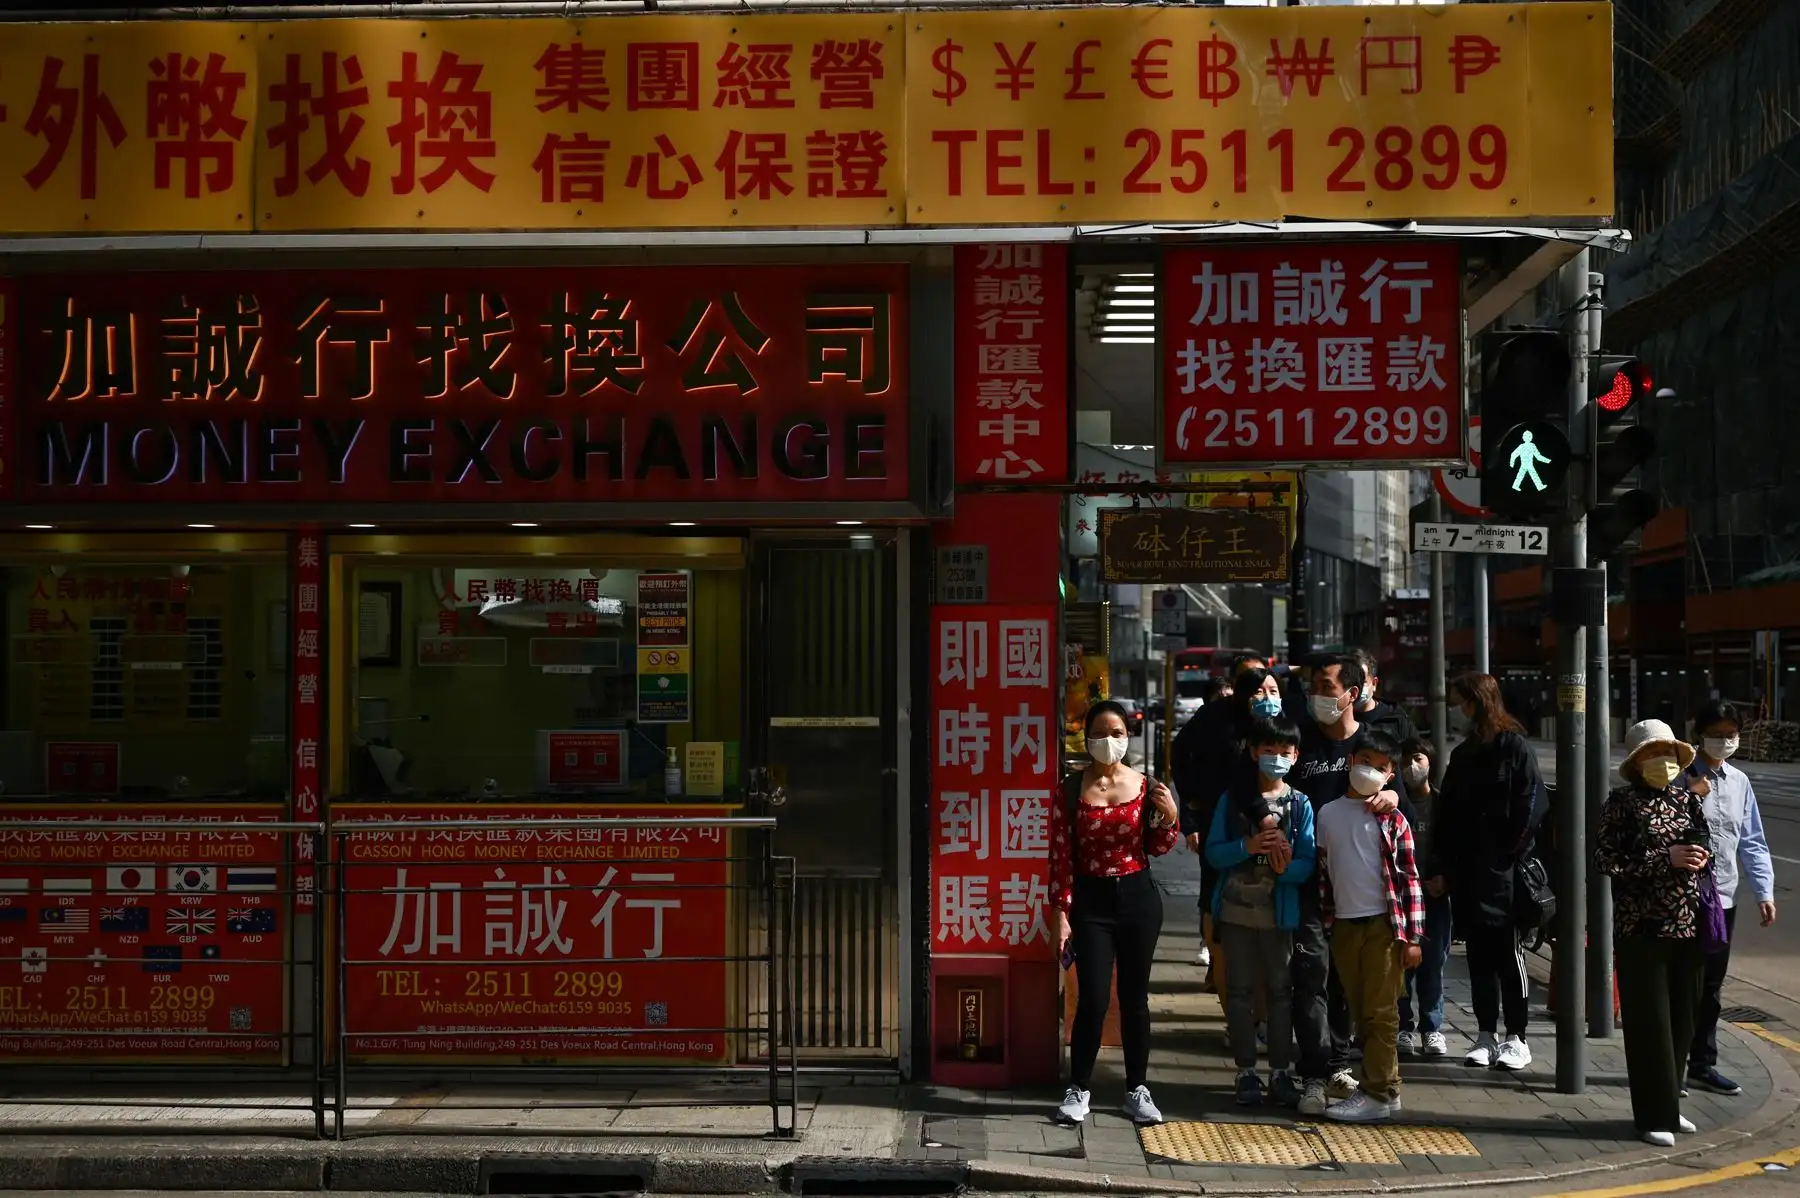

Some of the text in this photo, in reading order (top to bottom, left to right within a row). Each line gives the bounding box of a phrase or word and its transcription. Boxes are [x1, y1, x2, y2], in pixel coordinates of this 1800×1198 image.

[533, 38, 884, 113] 集團經營
[930, 38, 968, 107] $
[994, 41, 1037, 100] ¥
[1064, 40, 1106, 100] £
[1131, 38, 1174, 100] €
[531, 129, 888, 203] 信心保證
[931, 123, 1508, 197] TEL: 2511 2899
[1190, 258, 1433, 327] 加誠行
[42, 291, 891, 402] 加誠行找換公司
[974, 245, 1045, 479] 加誠行匯款中心
[1176, 336, 1447, 395] 找換匯款
[1204, 405, 1449, 447] 2511 2899
[37, 413, 888, 486] MONEY EXCHANGE
[1420, 537, 1441, 548] 上午
[1475, 527, 1516, 539] midnight
[1519, 531, 1543, 550] 12
[1244, 558, 1272, 568] SNACK
[439, 578, 601, 603] 人民幣找換價
[297, 537, 318, 704] 集團經營
[938, 620, 991, 946] 即時到賬
[1000, 619, 1049, 946] 國內匯款
[50, 845, 103, 858] MONEY
[112, 845, 190, 858] EXCHANGE
[199, 844, 255, 857] LIMITED
[353, 845, 680, 859] CASSON HONG MONEY EXCHANGE LIMITED
[58, 897, 76, 905] IDR
[122, 897, 139, 905] JPY
[180, 896, 203, 905] KRW
[241, 896, 261, 905] THB
[378, 866, 681, 958] 加誠行
[53, 935, 75, 944] MYR
[119, 935, 139, 944] NZD
[179, 935, 198, 944] GBP
[242, 934, 263, 943] AUD
[23, 974, 230, 983] CAD CHF EUR TWD
[376, 970, 623, 997] TEL: 2511 2899
[65, 986, 131, 1010] 2511
[150, 985, 215, 1009] 2899
[420, 1000, 632, 1016] WhatsApp/WeChat:6159 9035
[172, 1010, 207, 1023] 9035
[108, 1039, 130, 1049] Des
[132, 1039, 159, 1049] Voeux
[161, 1038, 185, 1049] Road
[255, 1038, 280, 1051] Kong
[403, 1038, 427, 1053] Tung
[429, 1038, 453, 1053] Ning
[540, 1039, 558, 1051] Des
[562, 1039, 591, 1051] Voeux
[594, 1039, 618, 1051] Road
[688, 1039, 714, 1054] Kong
